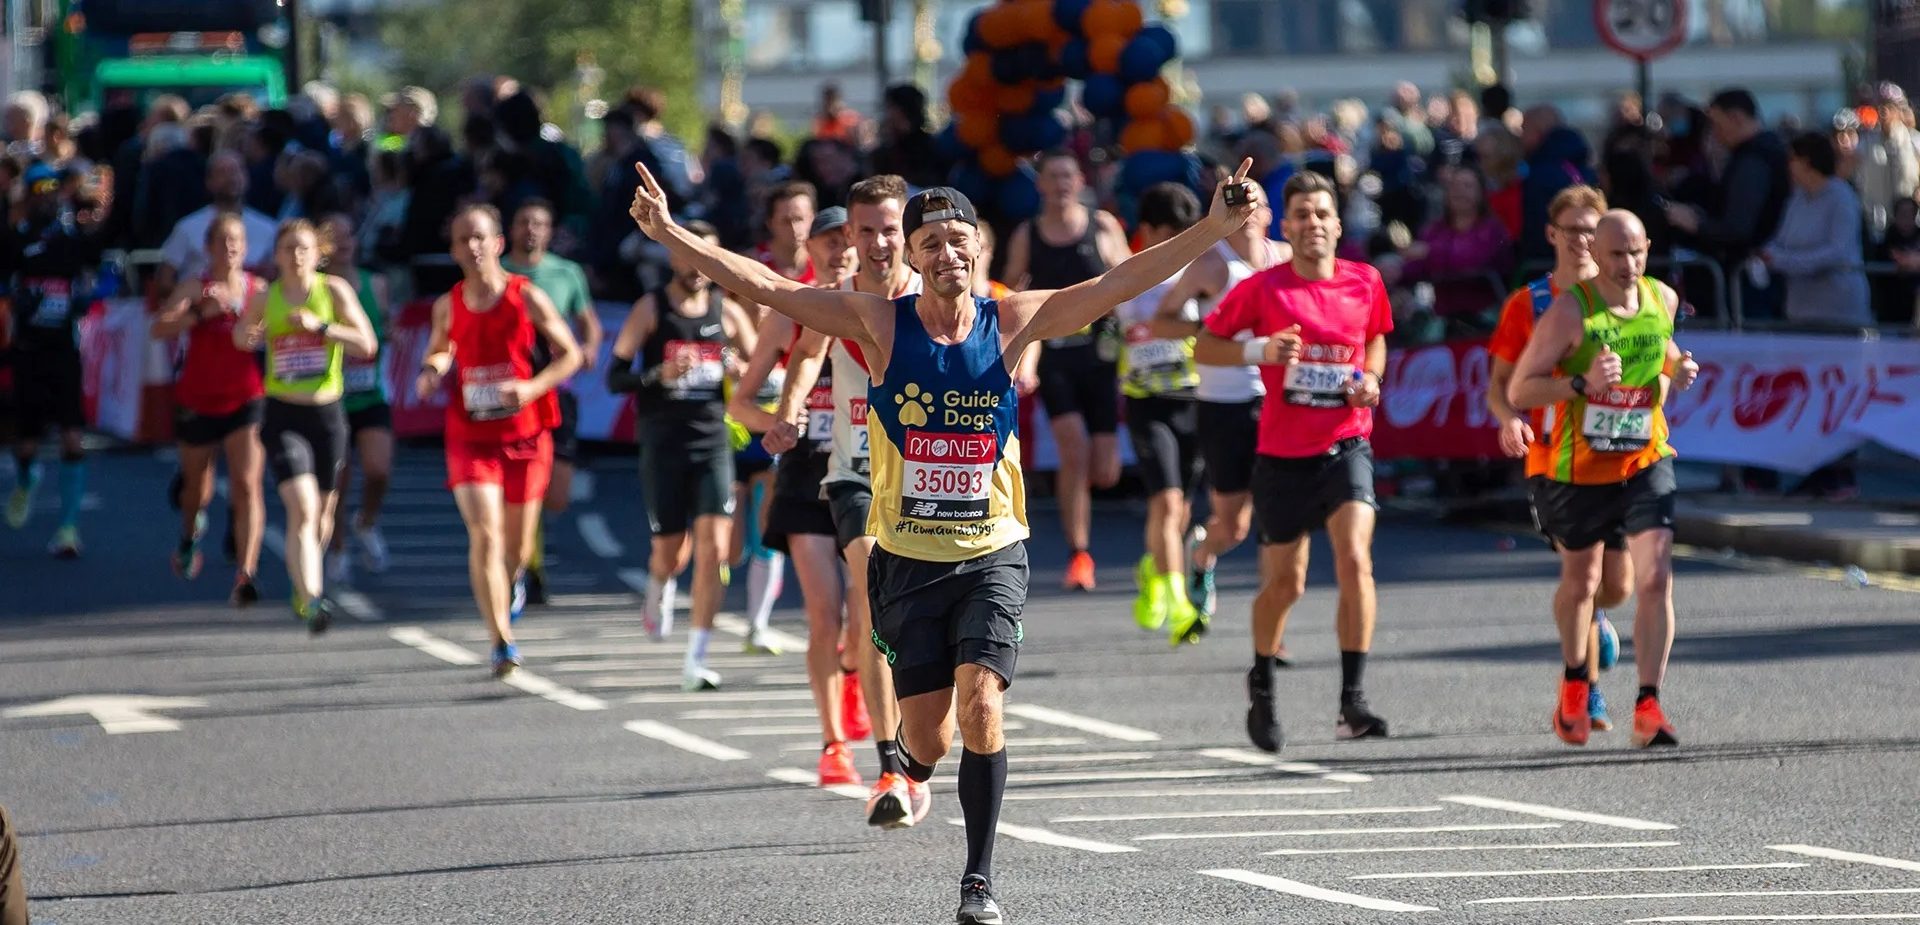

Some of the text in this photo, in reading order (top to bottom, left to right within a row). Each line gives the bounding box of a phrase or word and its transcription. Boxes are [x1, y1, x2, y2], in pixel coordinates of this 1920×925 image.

[943, 390, 1000, 408] Guide
[944, 409, 994, 431] Dogs
[909, 437, 992, 458] MONEY
[914, 468, 983, 494] 35093
[954, 510, 983, 518] balance
